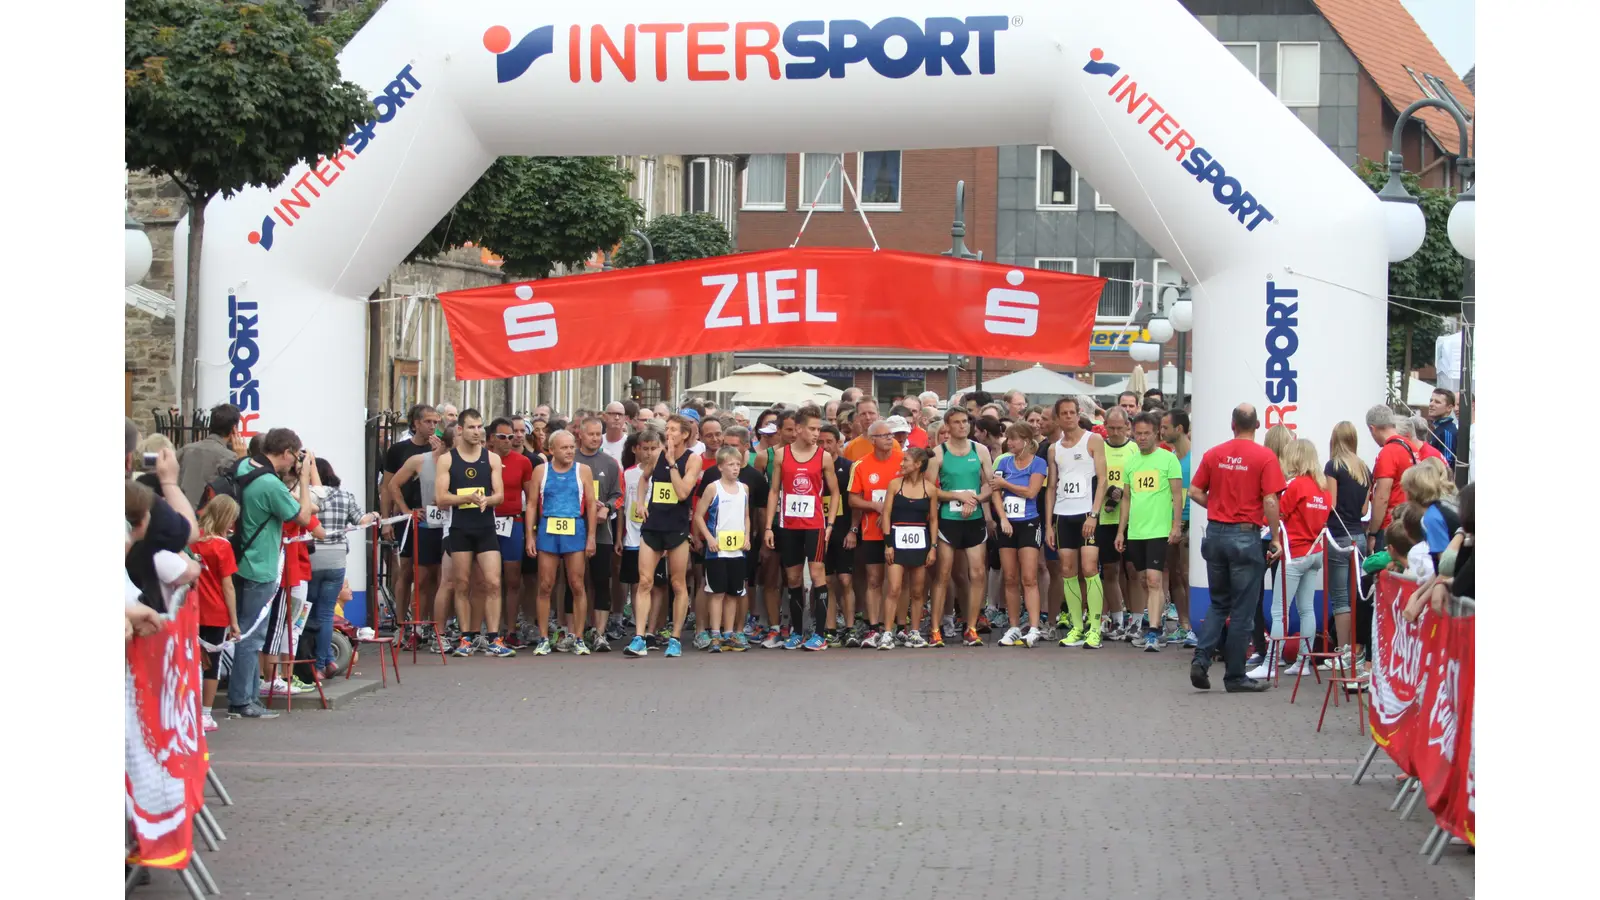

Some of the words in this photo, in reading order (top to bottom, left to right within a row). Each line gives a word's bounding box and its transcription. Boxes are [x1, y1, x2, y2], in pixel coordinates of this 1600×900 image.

[569, 15, 1009, 83] INTERSPORT
[1108, 74, 1274, 232] INTERSPORT
[702, 268, 838, 329] ZIEL
[1108, 470, 1121, 481] 83
[1063, 482, 1080, 494] 421
[1138, 477, 1155, 489] 142
[659, 488, 671, 500] 56
[791, 501, 809, 513] 417
[429, 508, 444, 520] 46
[555, 520, 568, 531] 58
[726, 535, 738, 547] 81
[901, 533, 920, 544] 460
